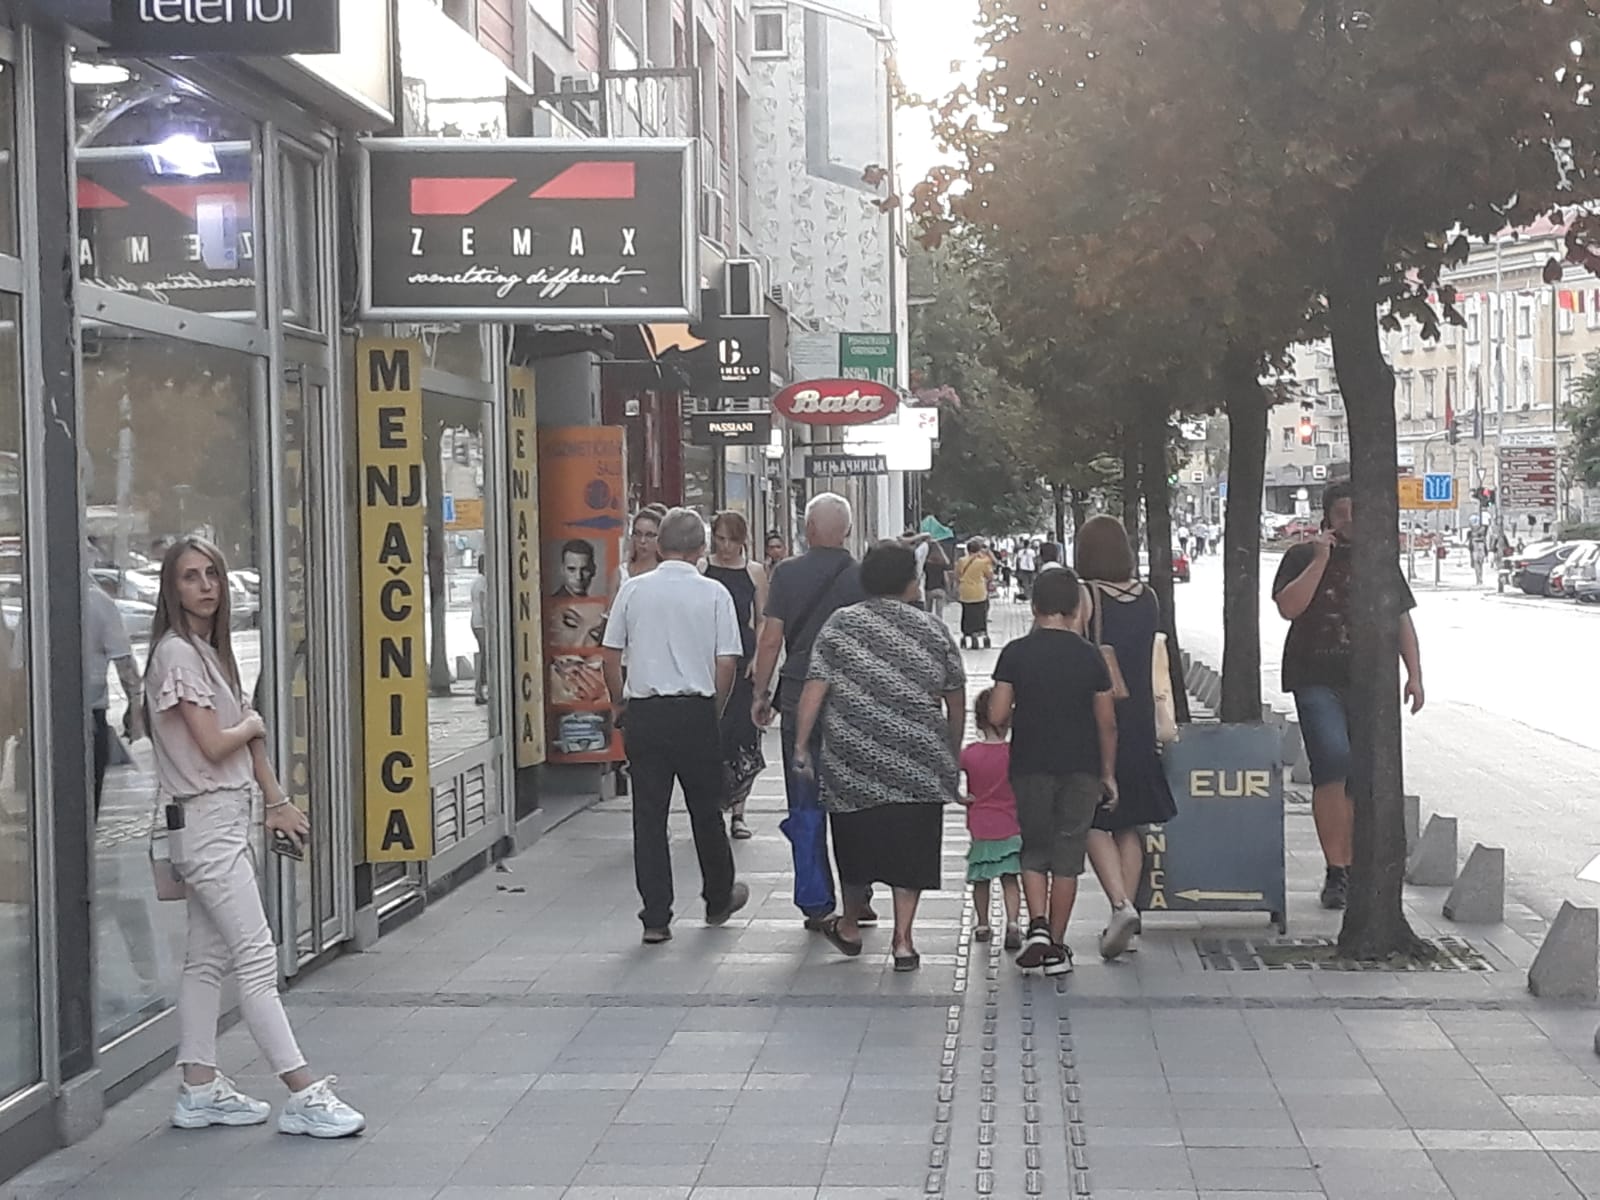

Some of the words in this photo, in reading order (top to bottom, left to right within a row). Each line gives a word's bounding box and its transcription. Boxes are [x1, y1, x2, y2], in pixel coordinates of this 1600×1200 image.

[410, 227, 636, 256] ZEMAX
[408, 265, 522, 299] something
[525, 266, 646, 299] different
[789, 390, 884, 414] Bata
[512, 387, 534, 744] MENJAČNICA
[366, 349, 423, 851] MENJAČNICA
[1190, 770, 1270, 797] EUR
